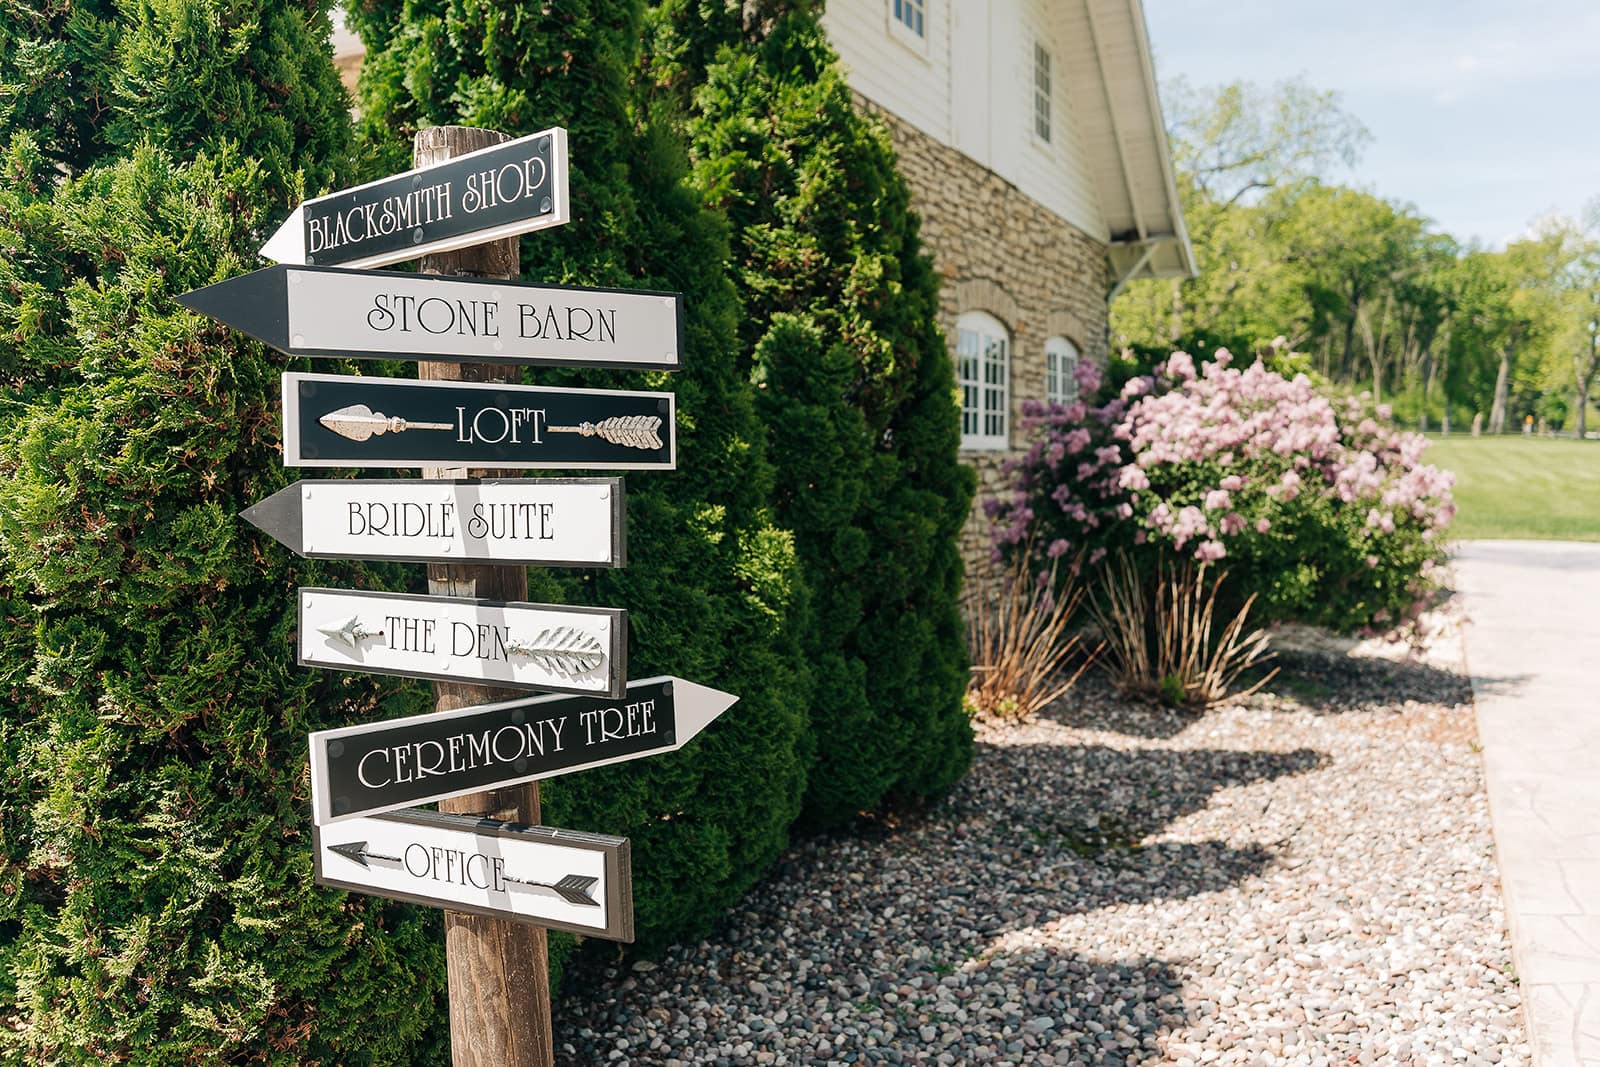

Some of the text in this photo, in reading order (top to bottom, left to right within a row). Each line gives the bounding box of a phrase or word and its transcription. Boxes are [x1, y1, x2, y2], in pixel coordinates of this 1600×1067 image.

[307, 155, 546, 255] BLACKSMITH SHOP
[366, 293, 617, 345] STONE BARN
[455, 406, 546, 445] LOFT
[347, 501, 555, 541] BRIDLE SUITE
[385, 615, 511, 663] THE DEN
[357, 699, 657, 789] CEREMONY TREE
[404, 842, 506, 893] OFFICE
